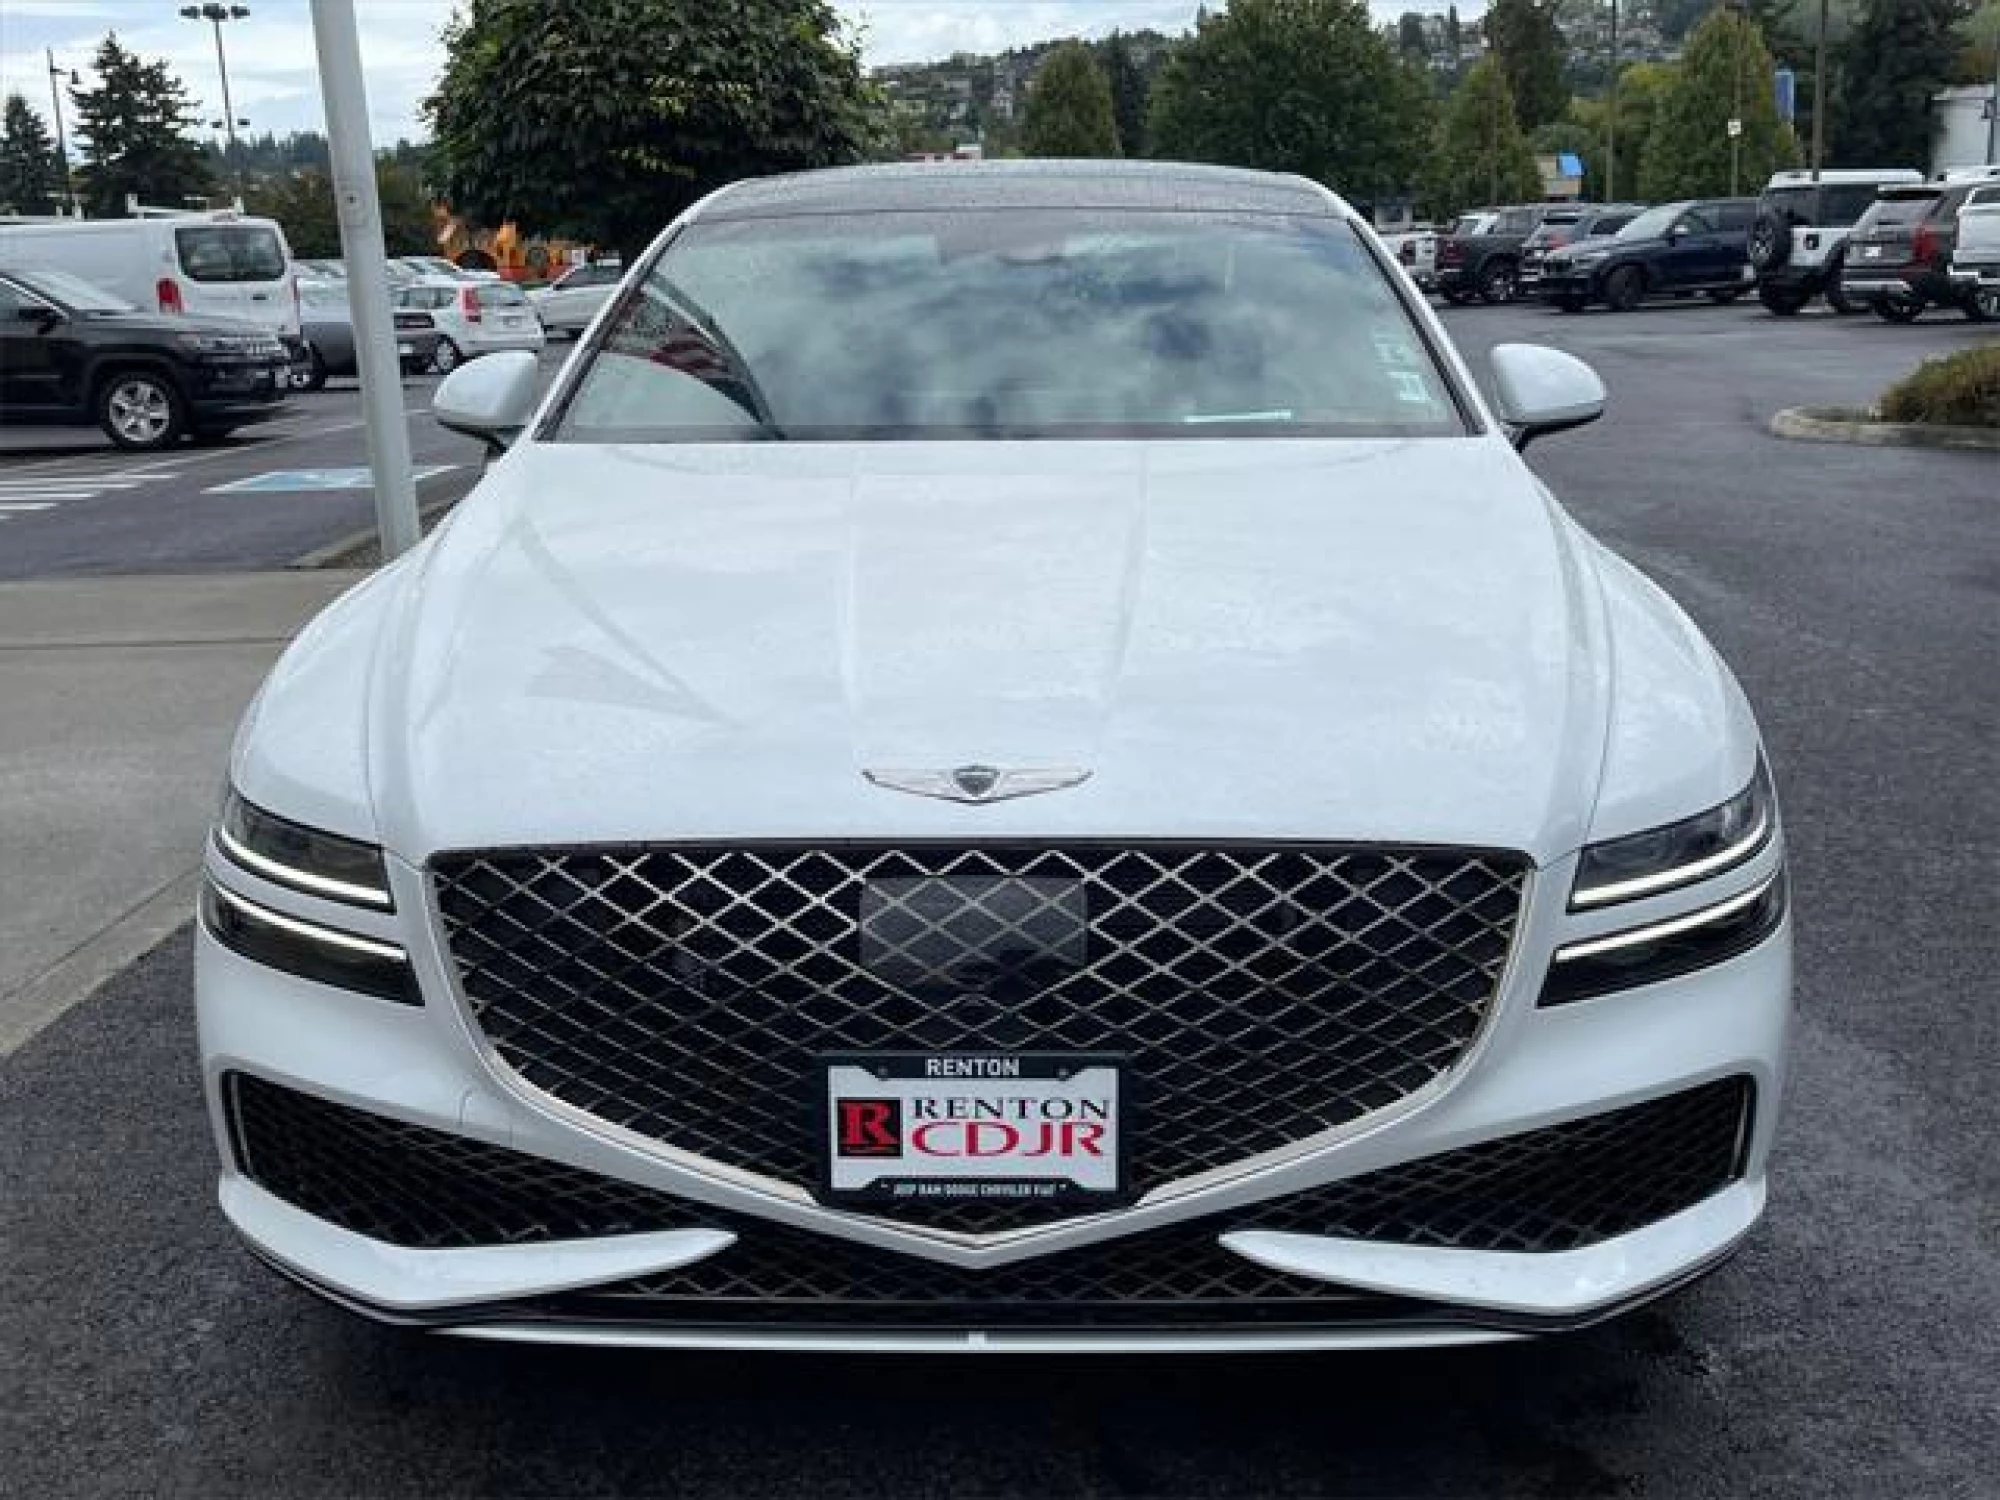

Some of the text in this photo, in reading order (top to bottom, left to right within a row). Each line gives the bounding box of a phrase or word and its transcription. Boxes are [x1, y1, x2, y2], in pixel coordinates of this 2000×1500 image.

[925, 1058, 1020, 1076] RENTON
[913, 1097, 1110, 1120] RENTON
[841, 1102, 900, 1147] R
[911, 1122, 1105, 1157] CDJR
